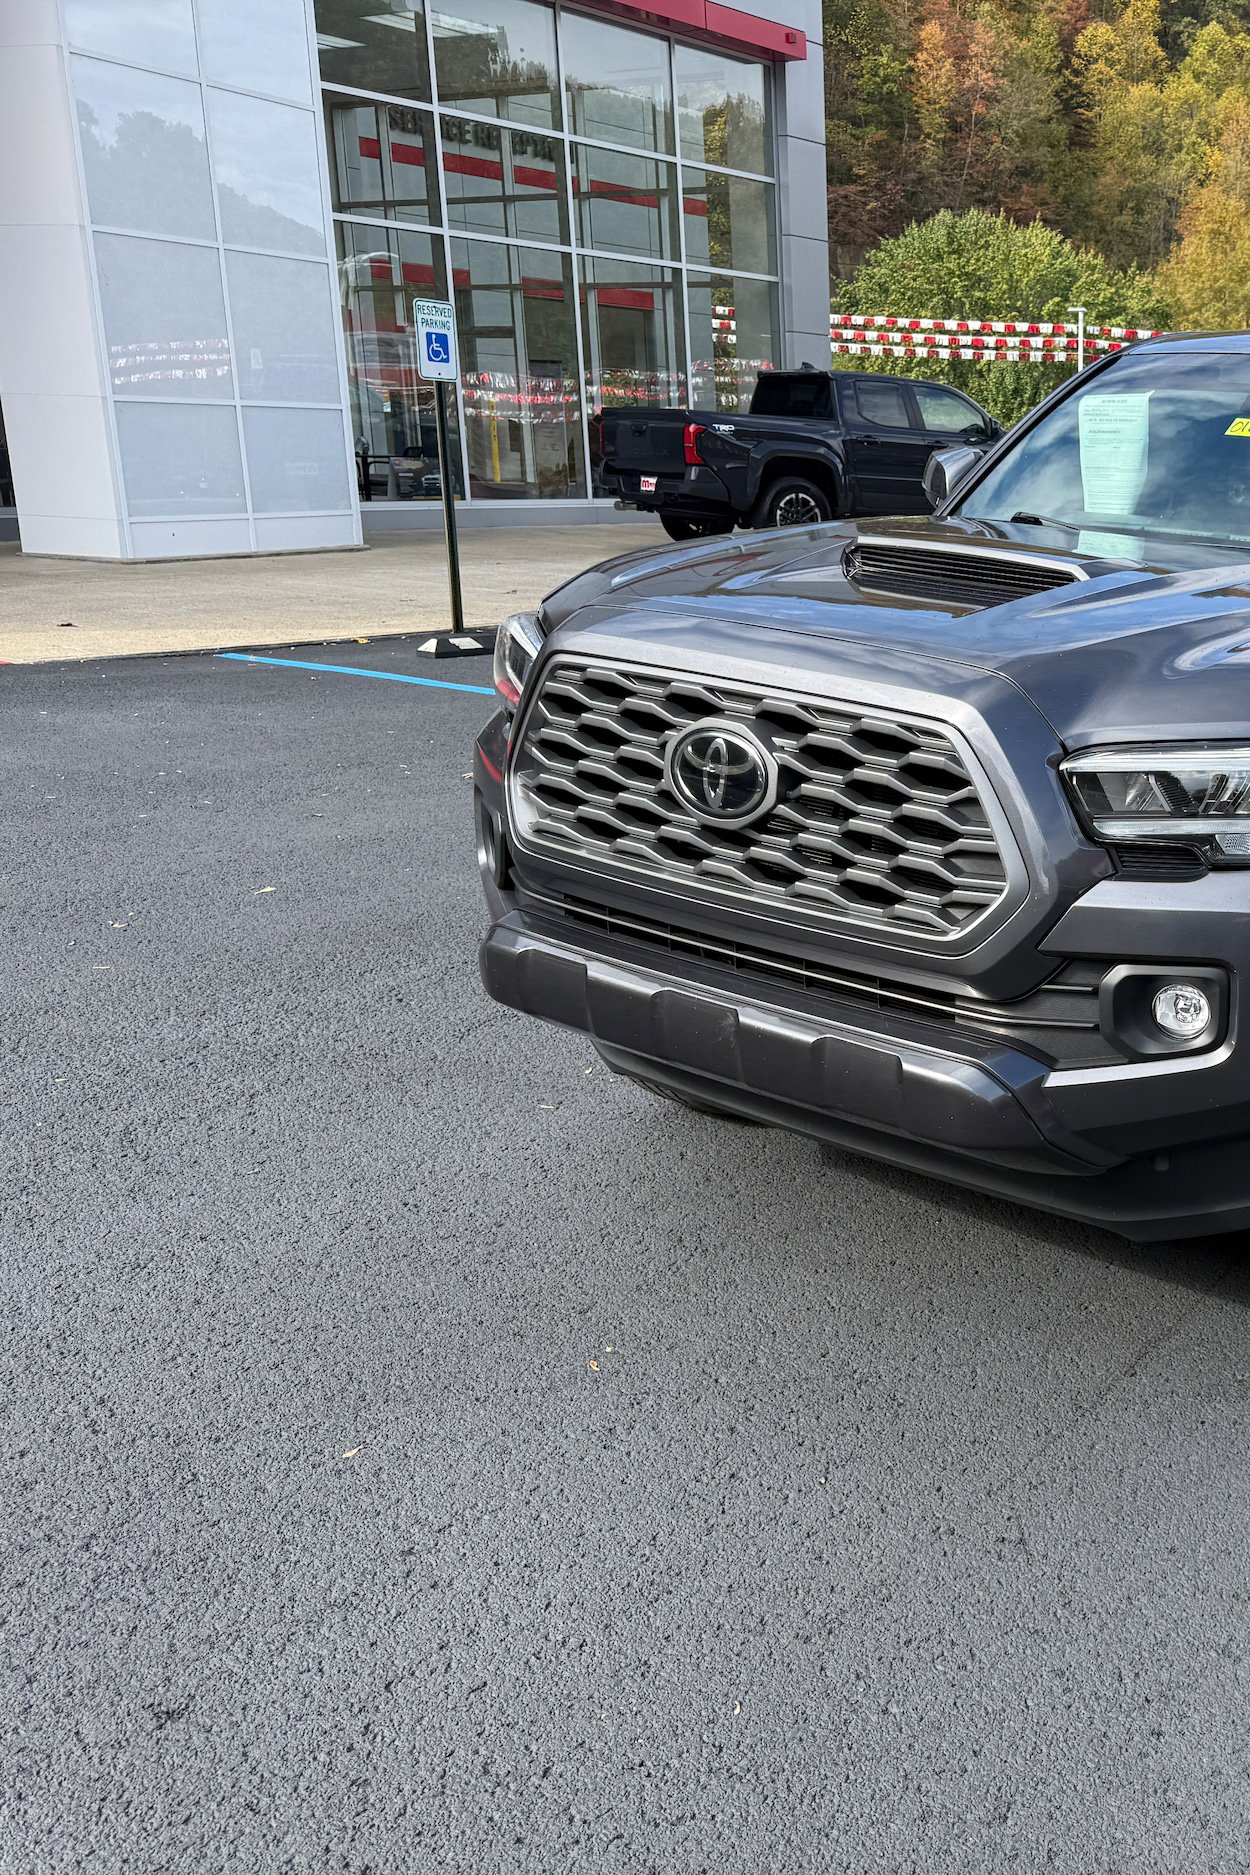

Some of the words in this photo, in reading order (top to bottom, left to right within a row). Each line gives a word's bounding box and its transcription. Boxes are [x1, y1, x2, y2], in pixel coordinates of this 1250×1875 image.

[417, 304, 452, 318] RESERVED
[421, 317, 451, 330] PARKING
[712, 423, 735, 432] TRD
